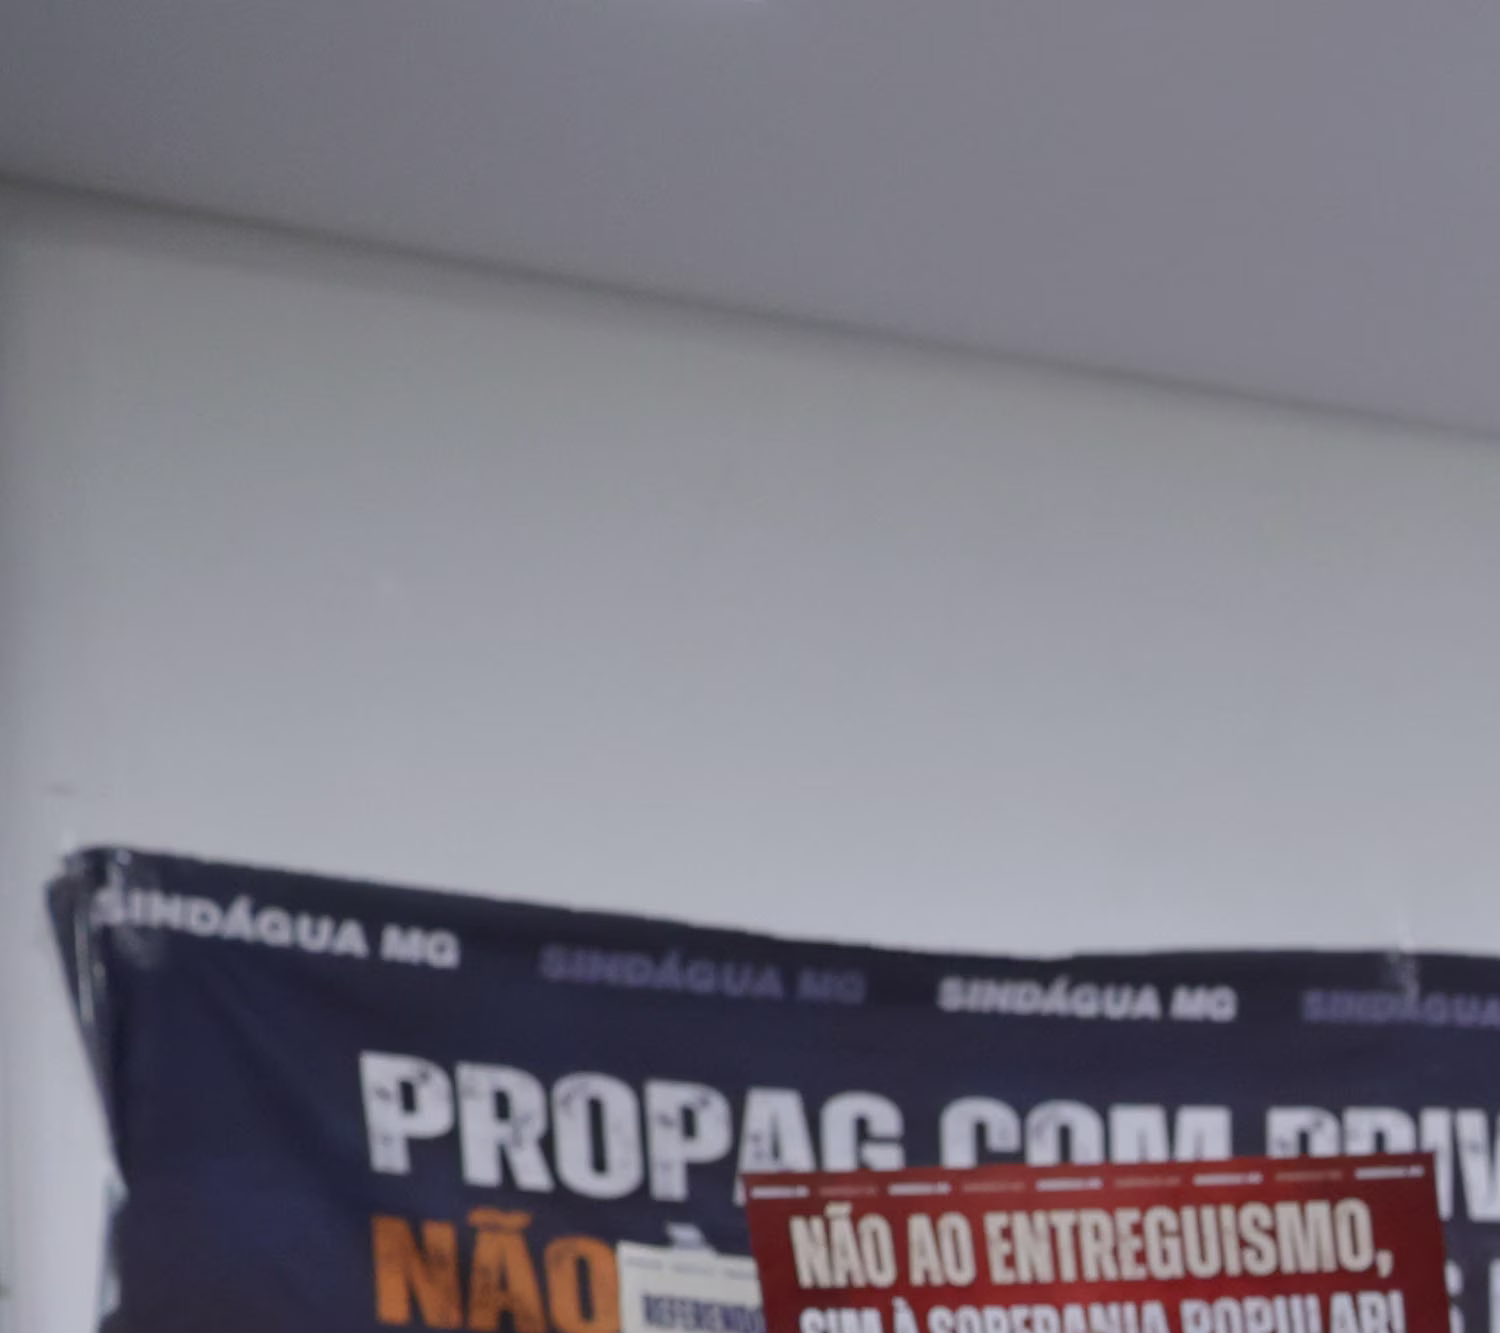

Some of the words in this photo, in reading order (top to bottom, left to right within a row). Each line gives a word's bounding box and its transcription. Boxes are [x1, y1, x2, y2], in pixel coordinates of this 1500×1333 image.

[380, 925, 461, 969] MG
[936, 975, 1160, 1020] SINDÁGUA
[1170, 979, 1237, 1023] MG
[359, 1050, 904, 1204] PROPAG
[939, 1095, 1233, 1172] COM
[789, 1202, 896, 1288] NÃO
[908, 1213, 976, 1287] AO
[983, 1197, 1393, 1285] ENTREGUISMO,
